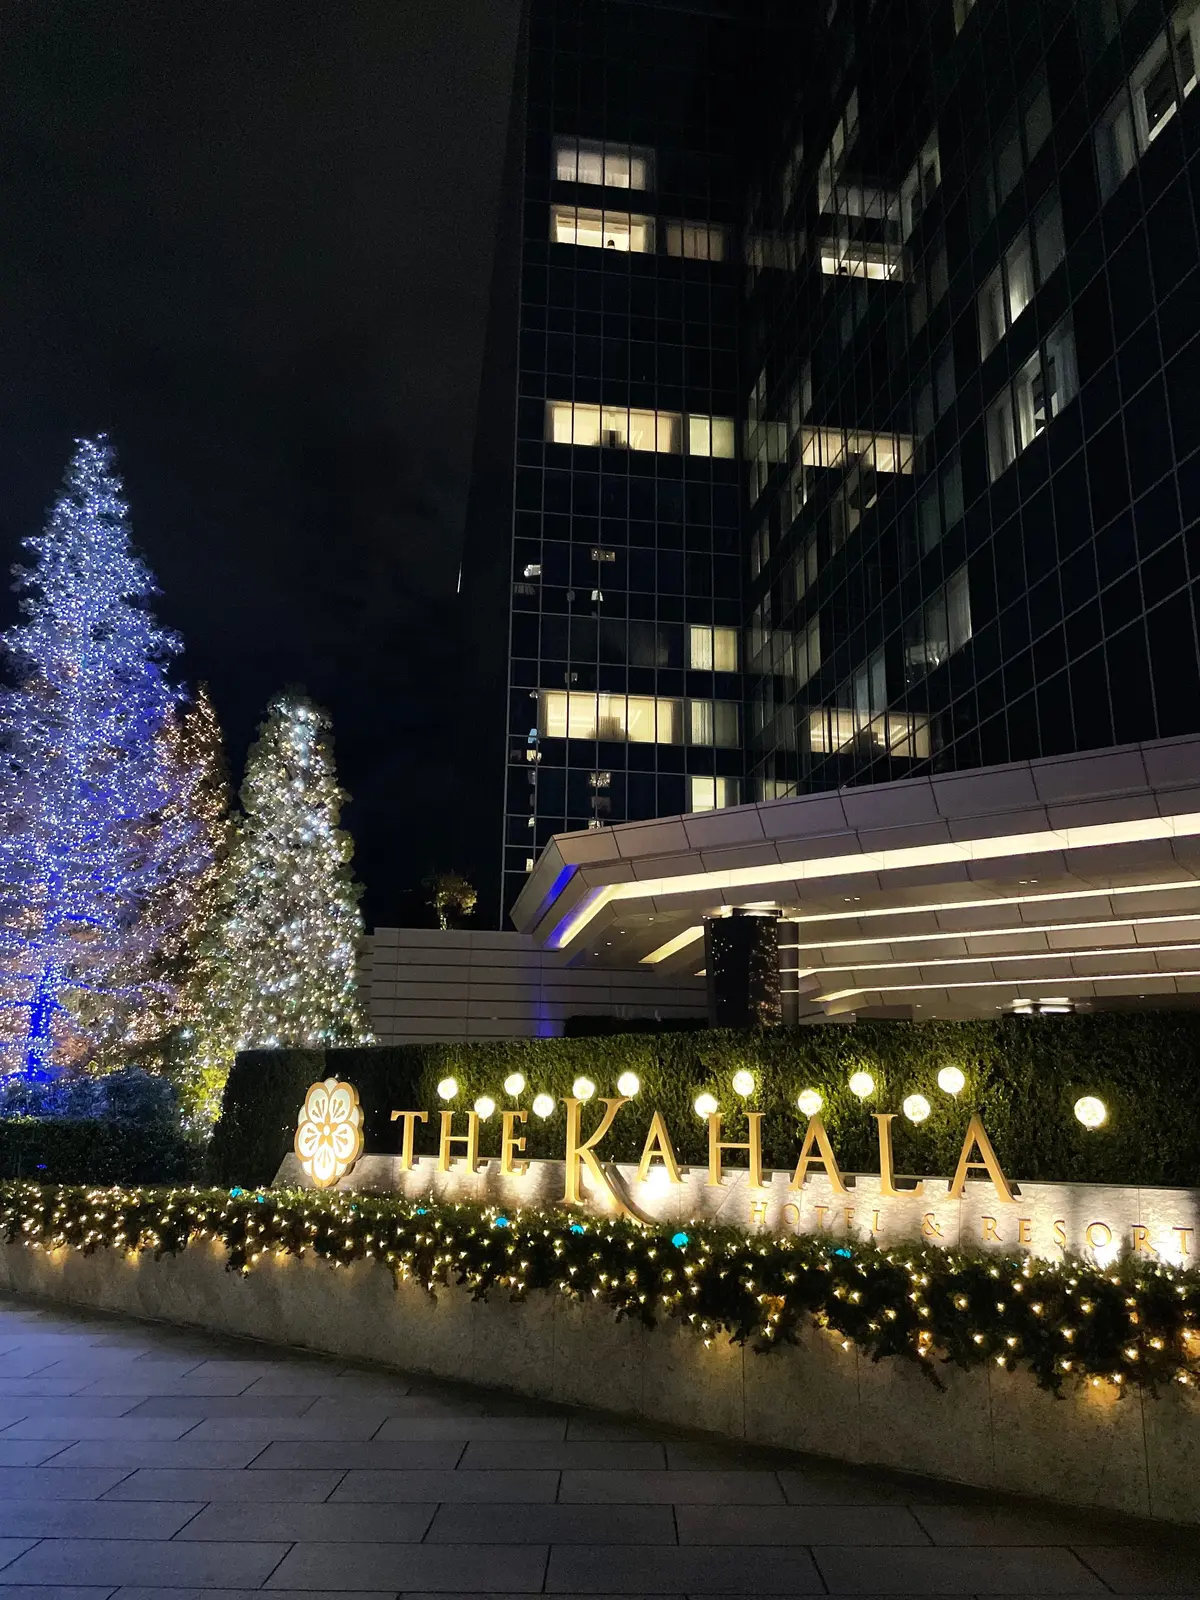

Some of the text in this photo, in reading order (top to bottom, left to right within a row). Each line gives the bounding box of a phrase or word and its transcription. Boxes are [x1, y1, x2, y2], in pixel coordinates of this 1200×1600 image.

[390, 1097, 1022, 1226] THE KAHALA
[748, 1201, 1195, 1255] HOTEL & RESORT
